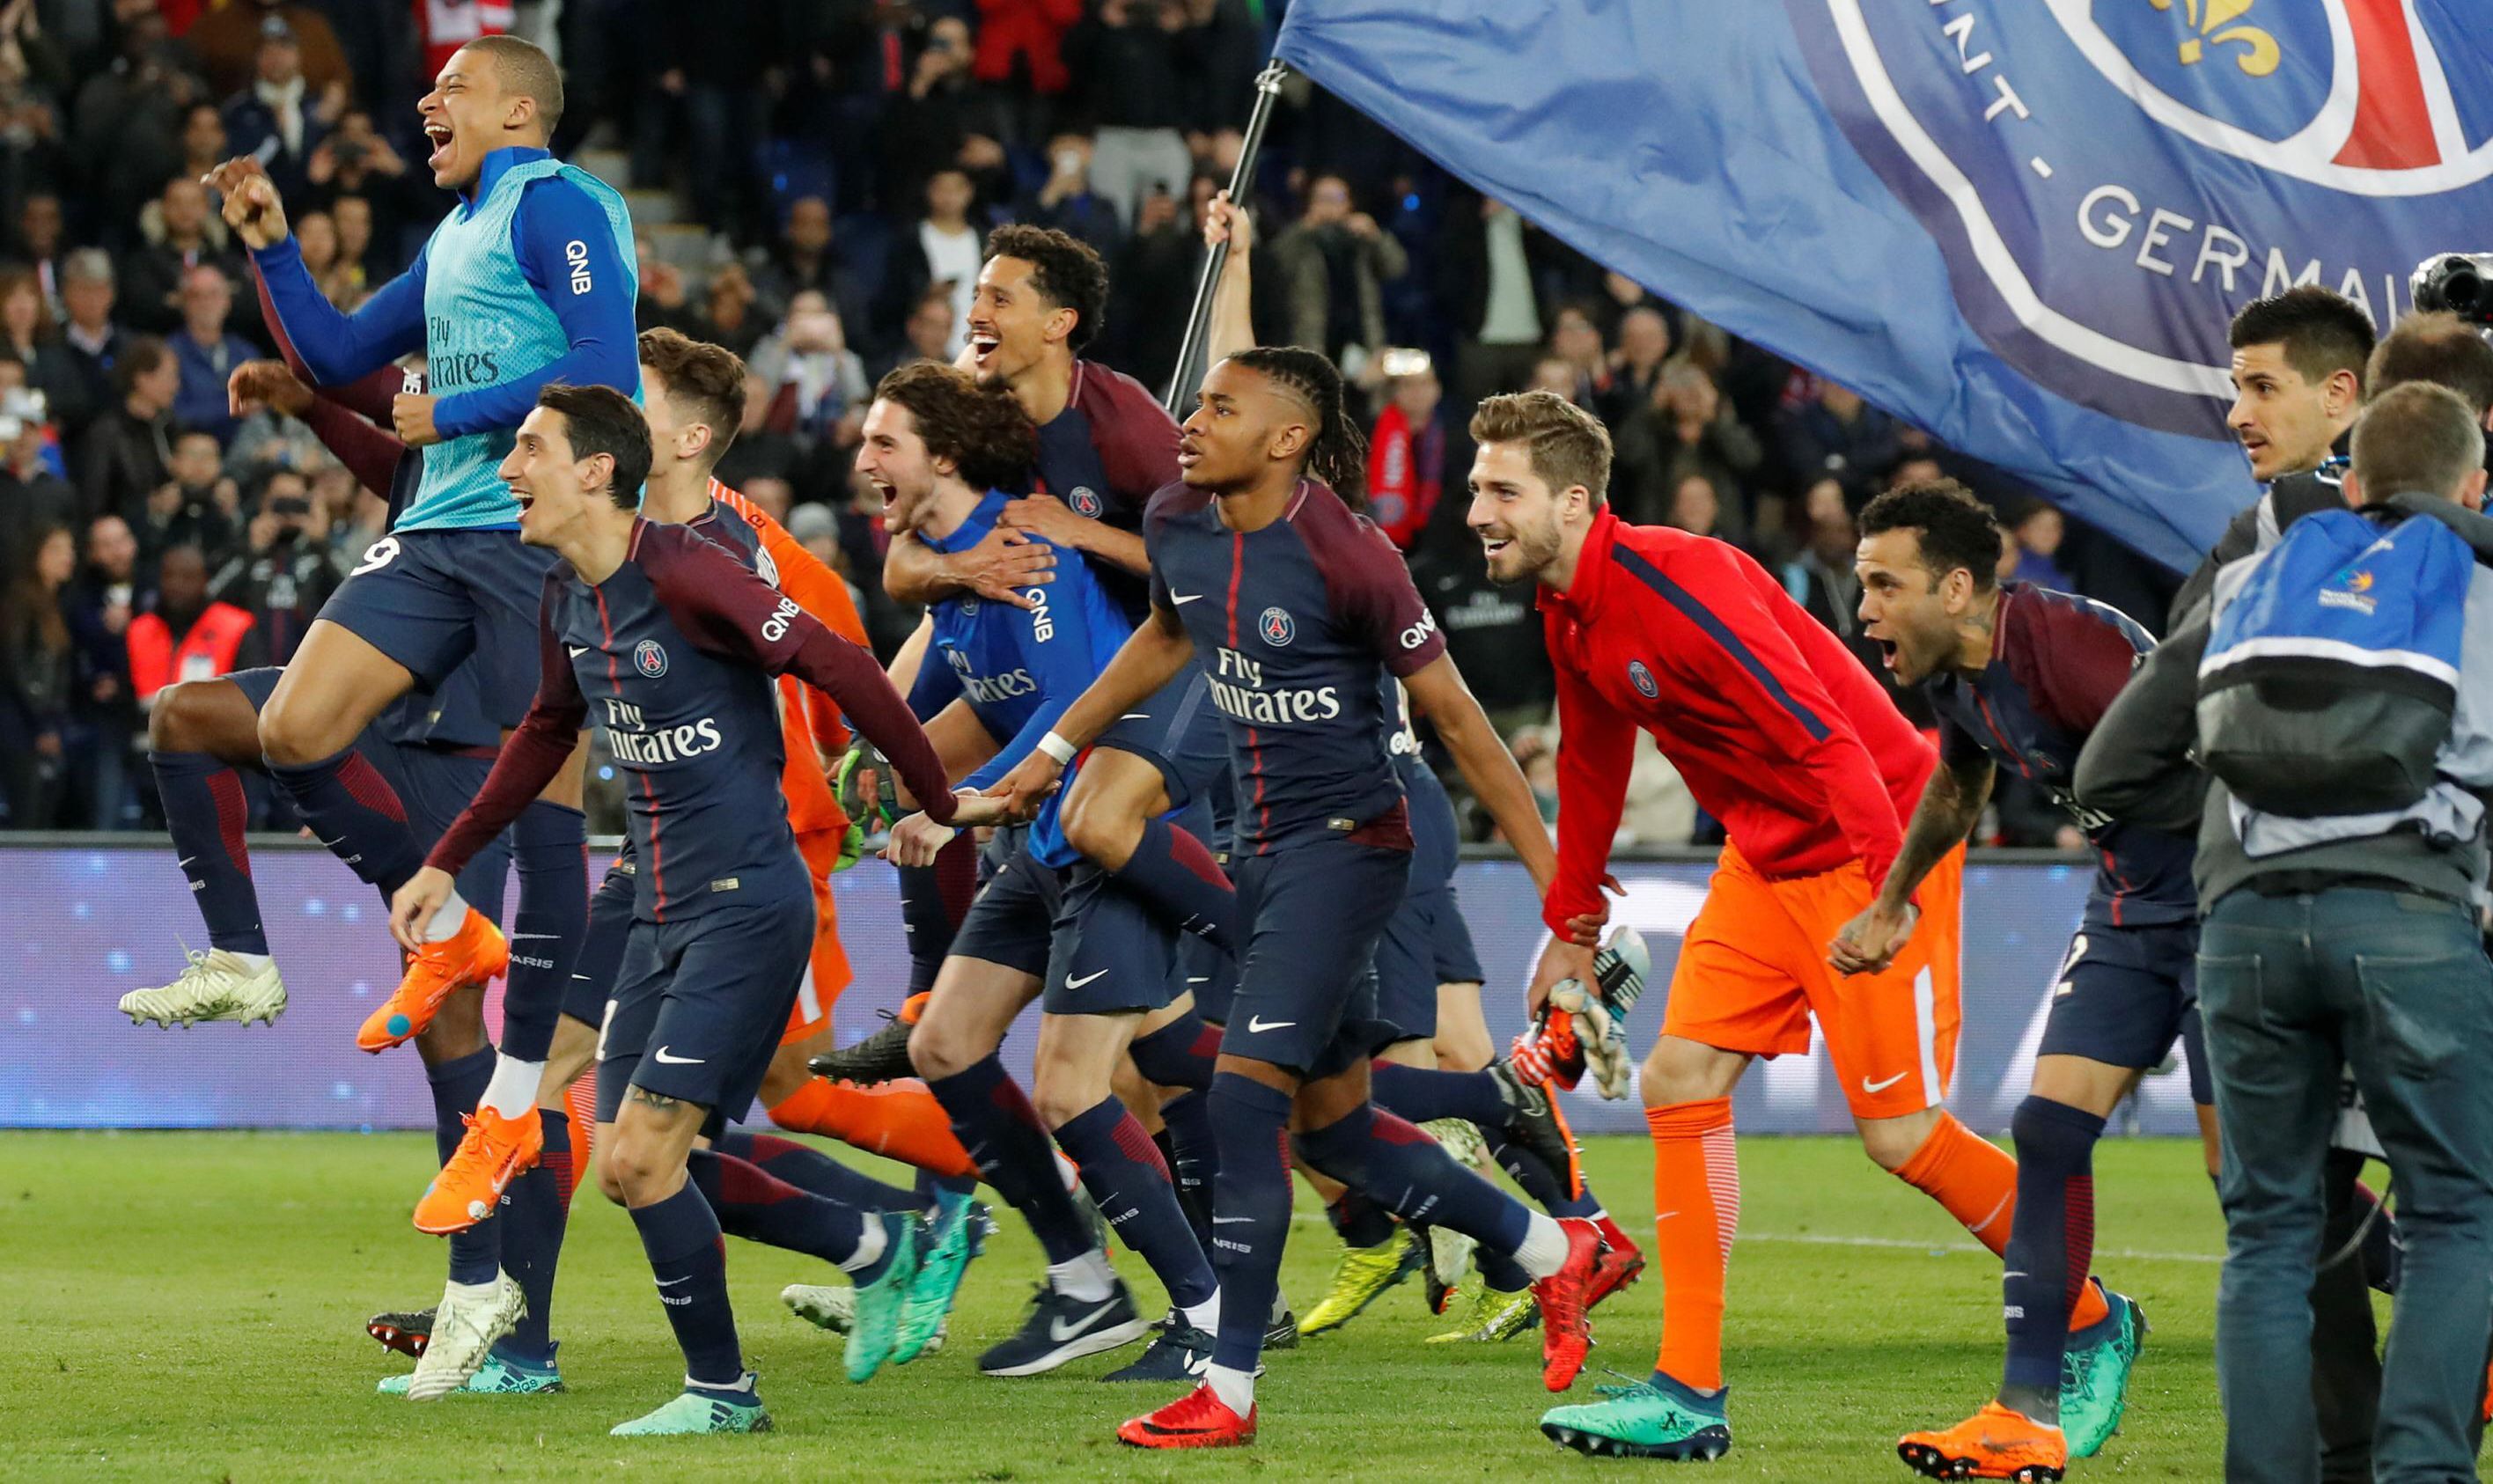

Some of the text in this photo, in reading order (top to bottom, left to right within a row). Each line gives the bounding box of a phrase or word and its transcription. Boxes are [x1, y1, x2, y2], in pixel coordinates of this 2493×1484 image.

[566, 239, 592, 296] QNB
[2077, 184, 2416, 333] GERMAI
[429, 315, 451, 348] Fly
[430, 349, 499, 388] irates
[761, 596, 800, 642] QNB
[1217, 647, 1263, 688] Fly
[603, 697, 646, 731] Fly
[1203, 668, 1341, 724] mirates
